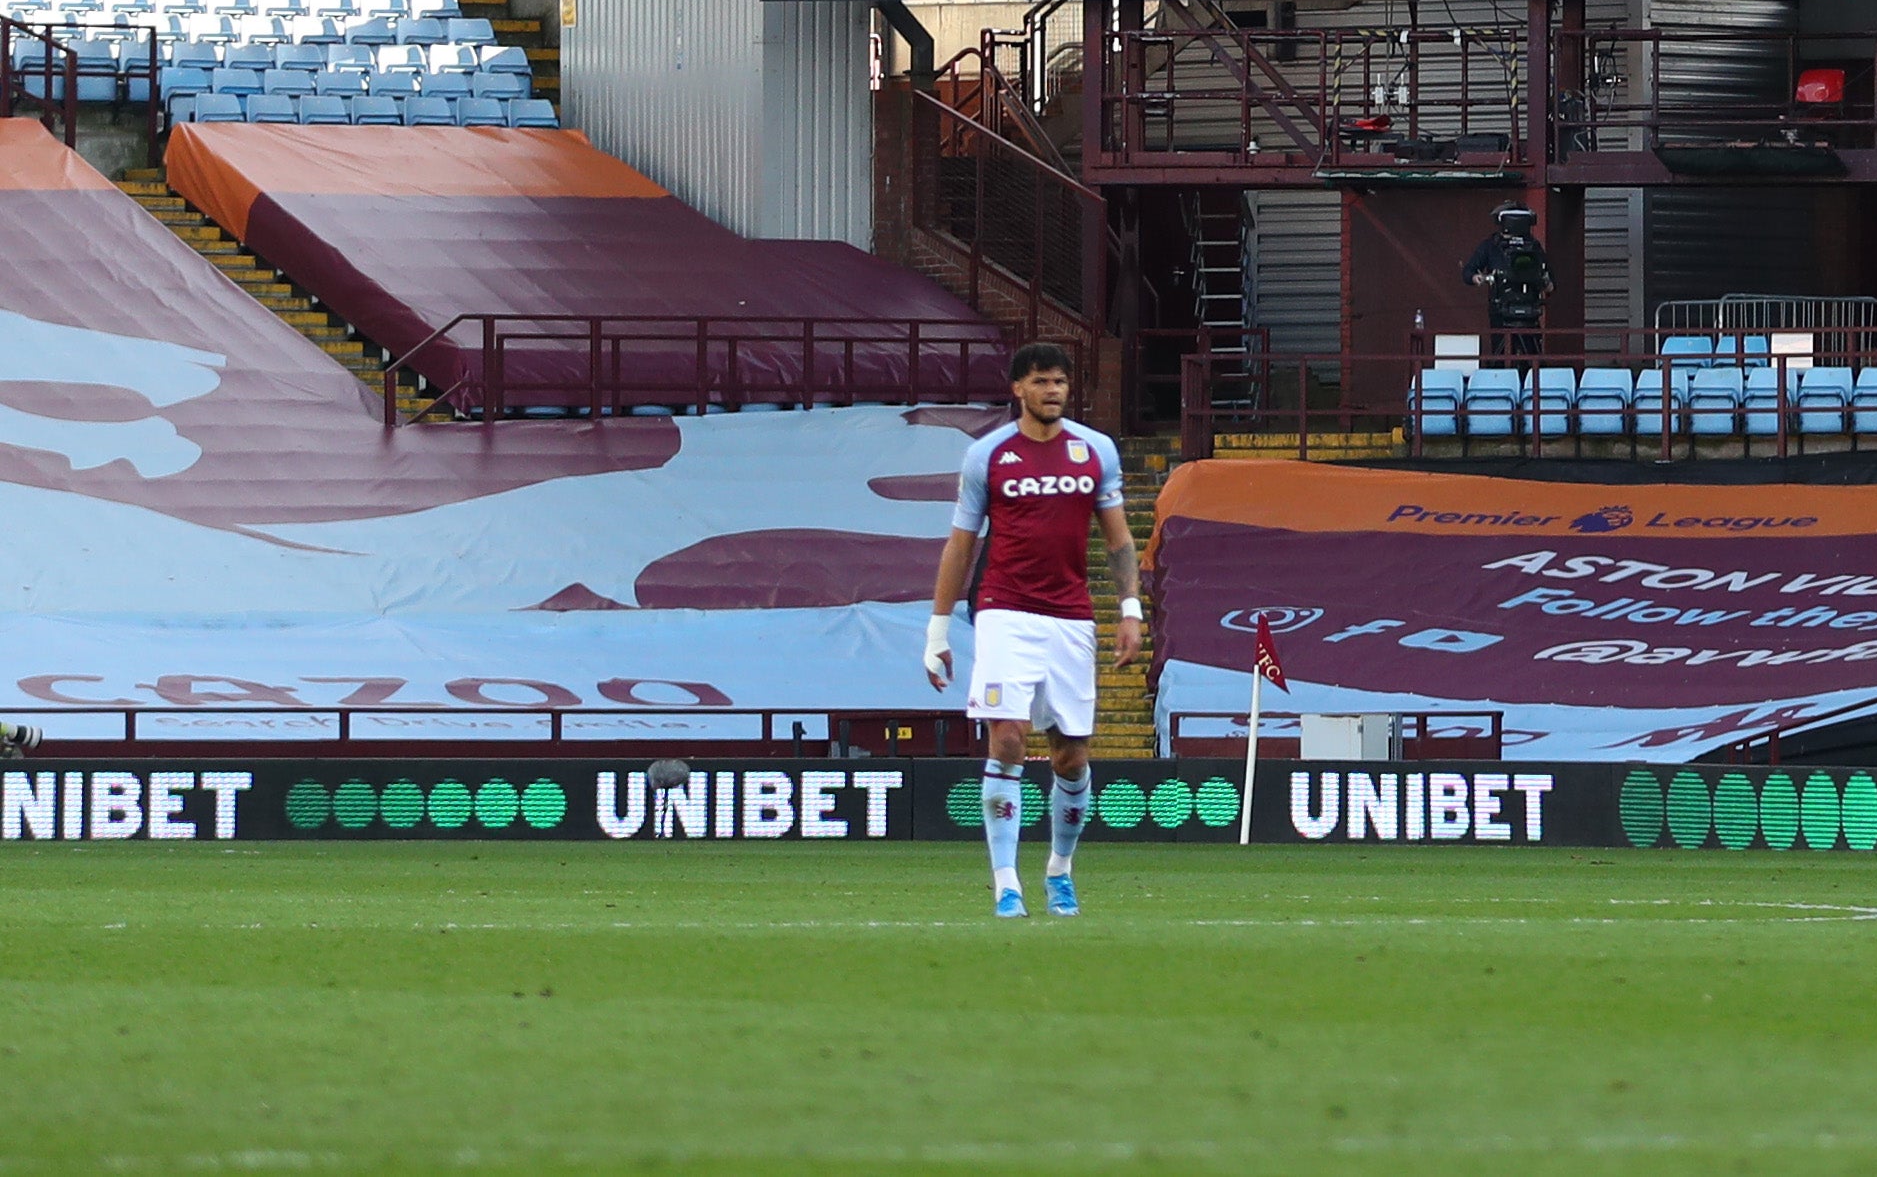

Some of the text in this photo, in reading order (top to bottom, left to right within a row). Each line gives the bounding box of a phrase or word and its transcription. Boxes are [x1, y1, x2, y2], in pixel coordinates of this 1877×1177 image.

[1002, 474, 1097, 499] CAZOO
[1386, 504, 1819, 532] Premier League
[1482, 549, 1782, 593] ASTON
[1498, 586, 1750, 626] Follow
[2, 771, 254, 840] NIBET
[596, 771, 904, 839] UNIBET
[1289, 771, 1553, 840] UNIBET
